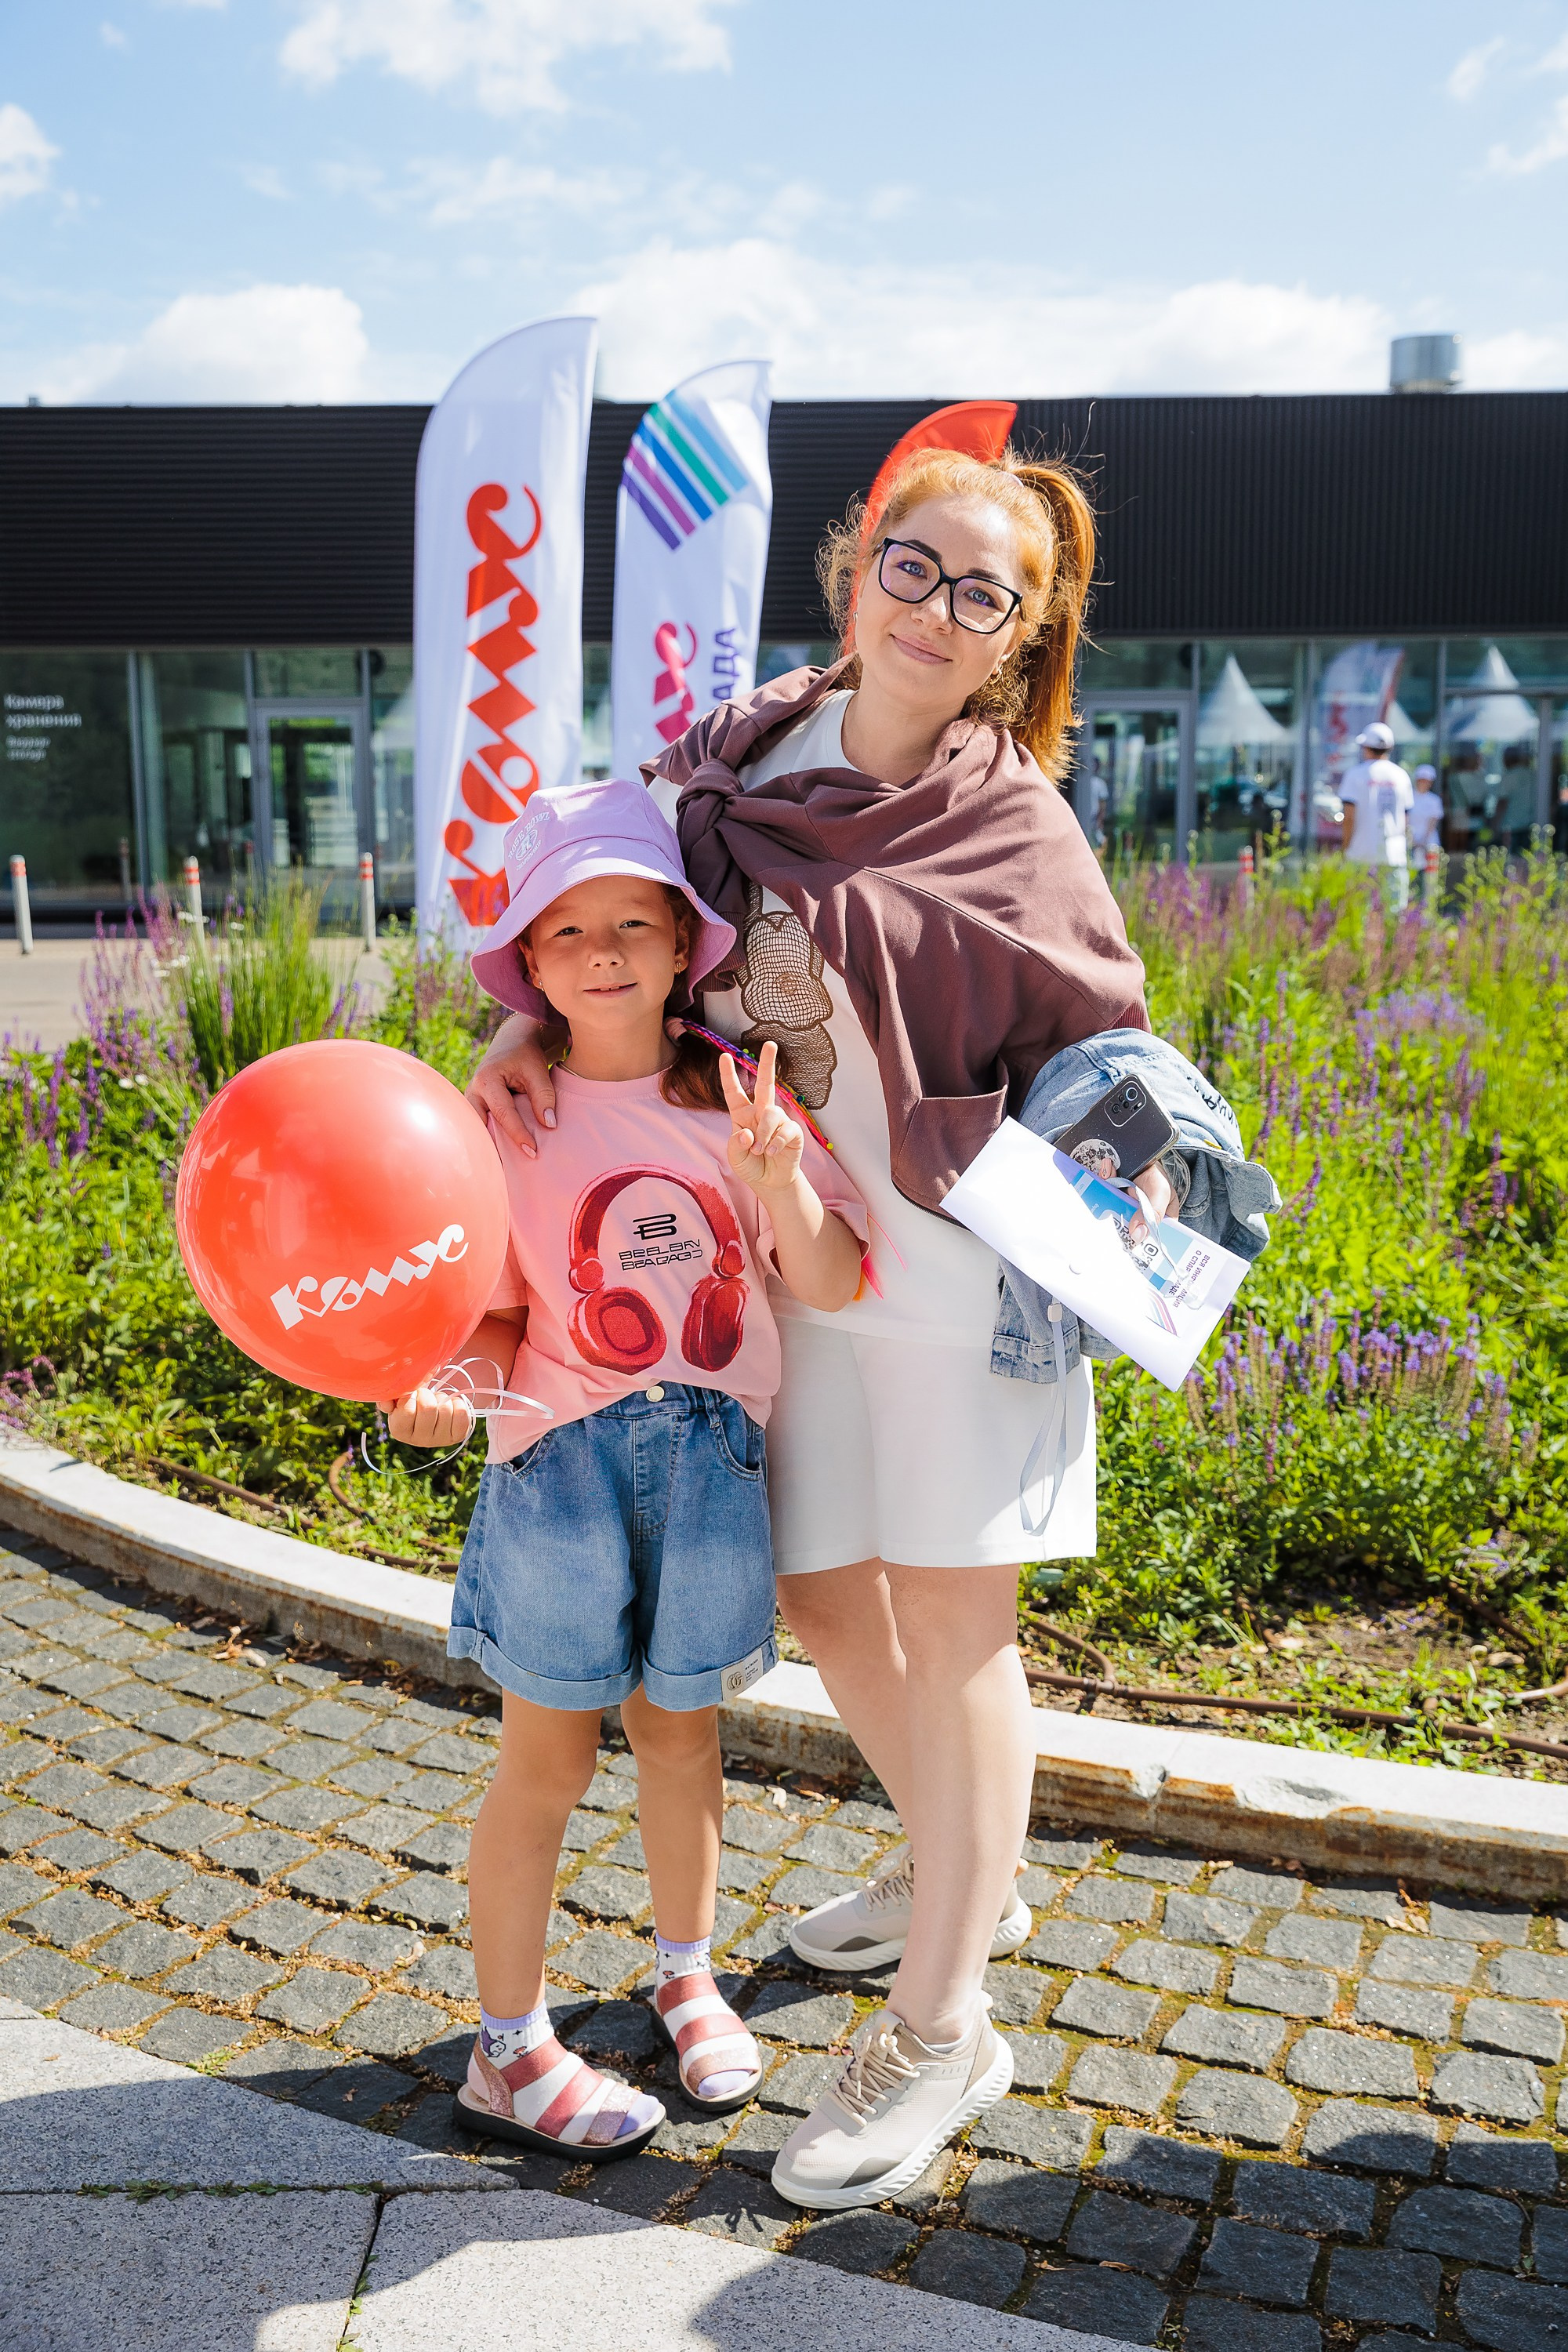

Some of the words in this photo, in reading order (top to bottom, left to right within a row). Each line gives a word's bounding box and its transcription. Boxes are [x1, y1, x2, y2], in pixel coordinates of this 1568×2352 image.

[713, 628, 741, 700] АДА
[507, 830, 525, 859] ROSE
[1199, 1254, 1210, 1268] ВСЯ
